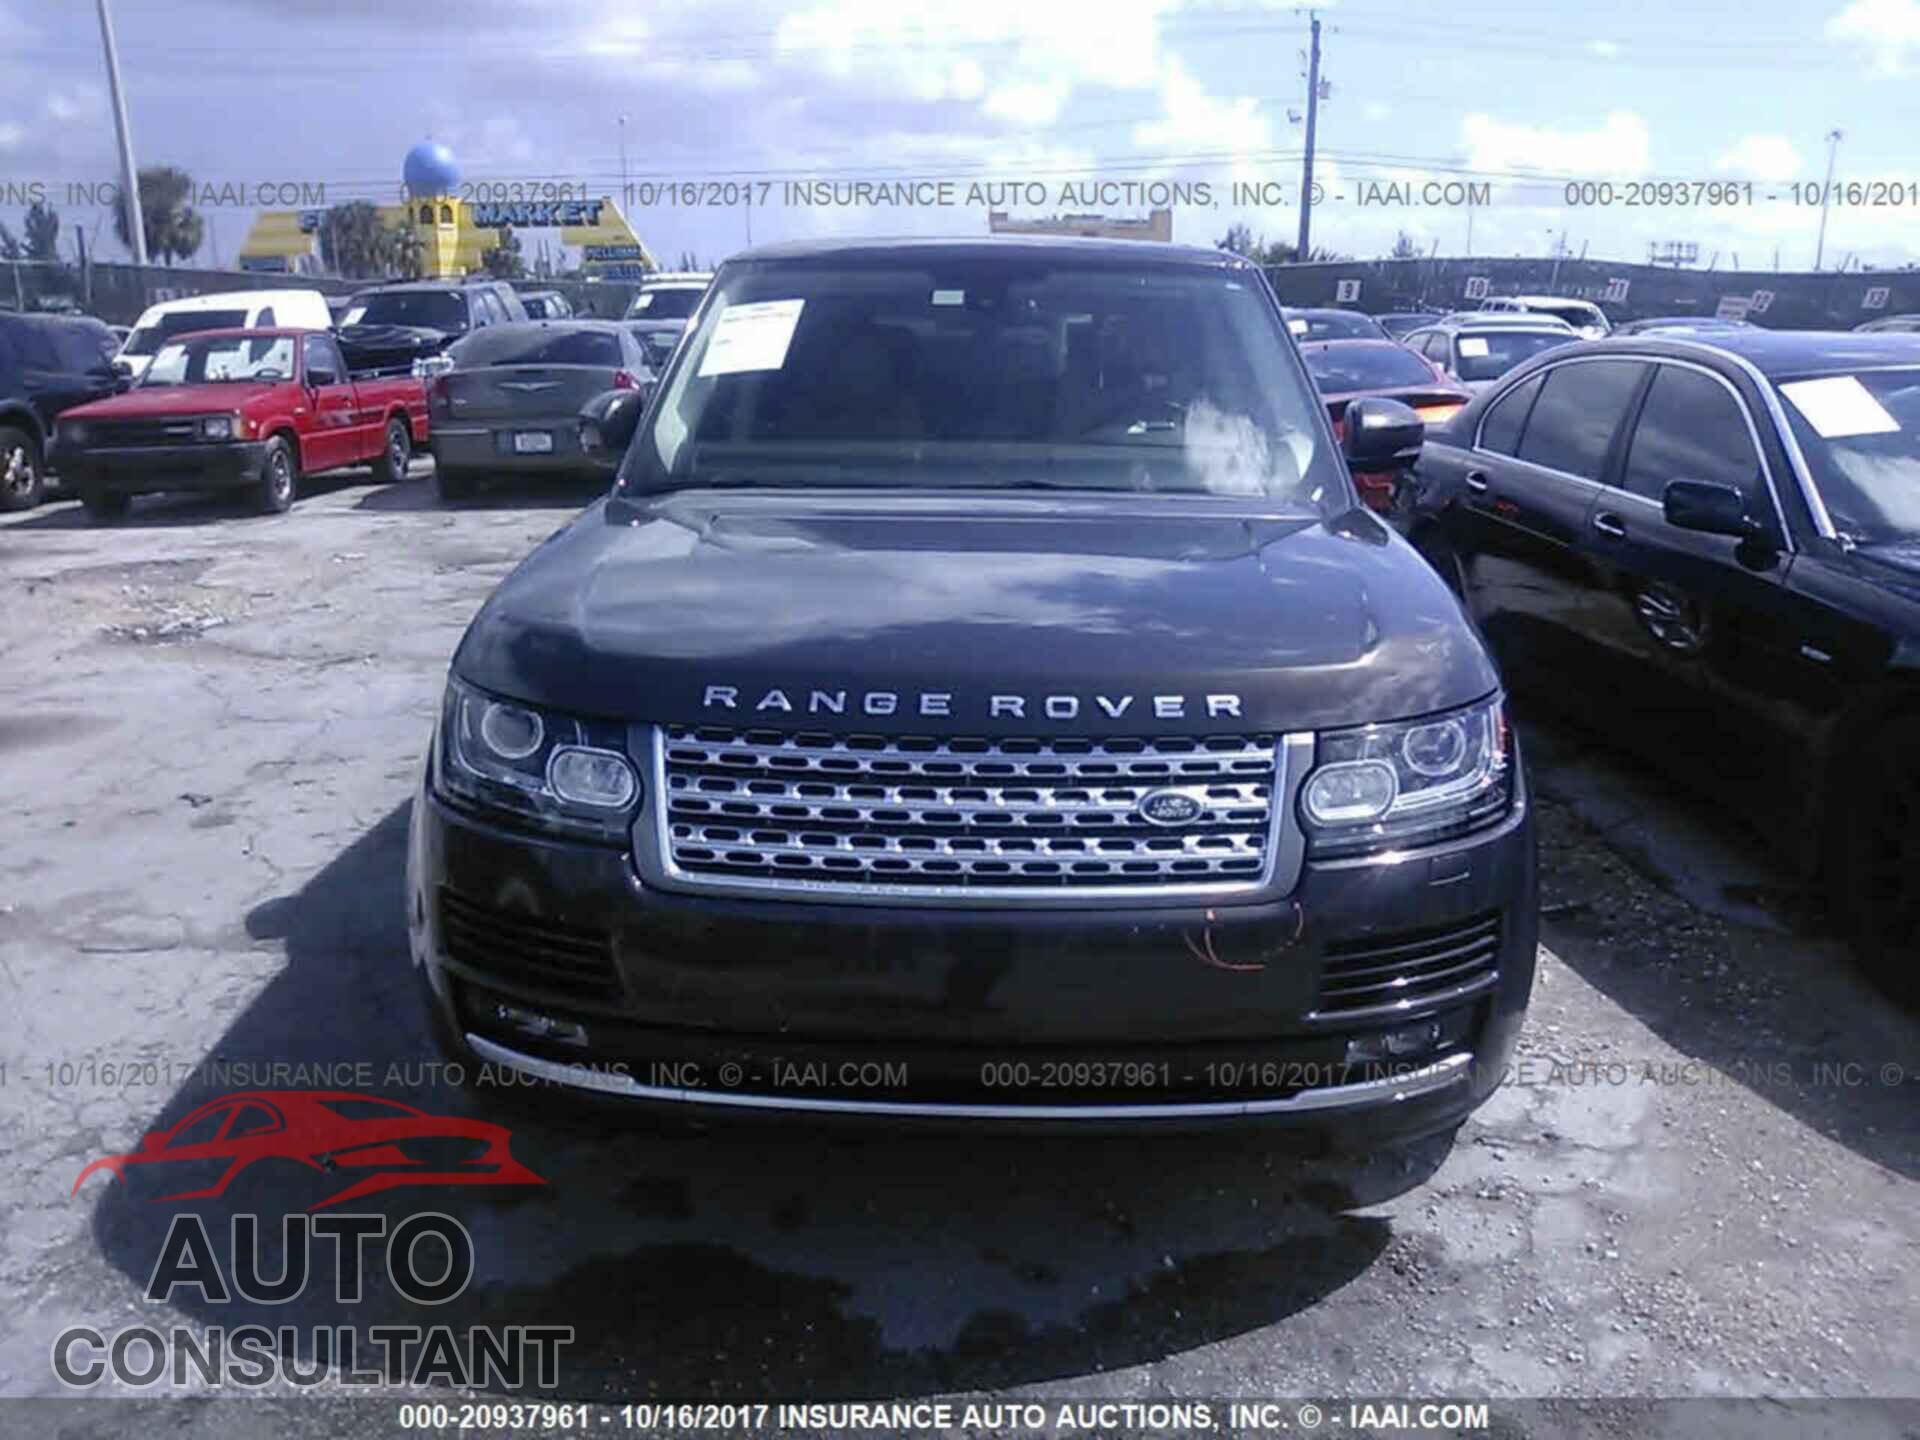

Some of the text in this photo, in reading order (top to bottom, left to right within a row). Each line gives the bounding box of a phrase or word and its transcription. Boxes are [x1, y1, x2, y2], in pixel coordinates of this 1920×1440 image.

[473, 199, 604, 228] MARKET
[702, 685, 1242, 718] RANGE ROVER
